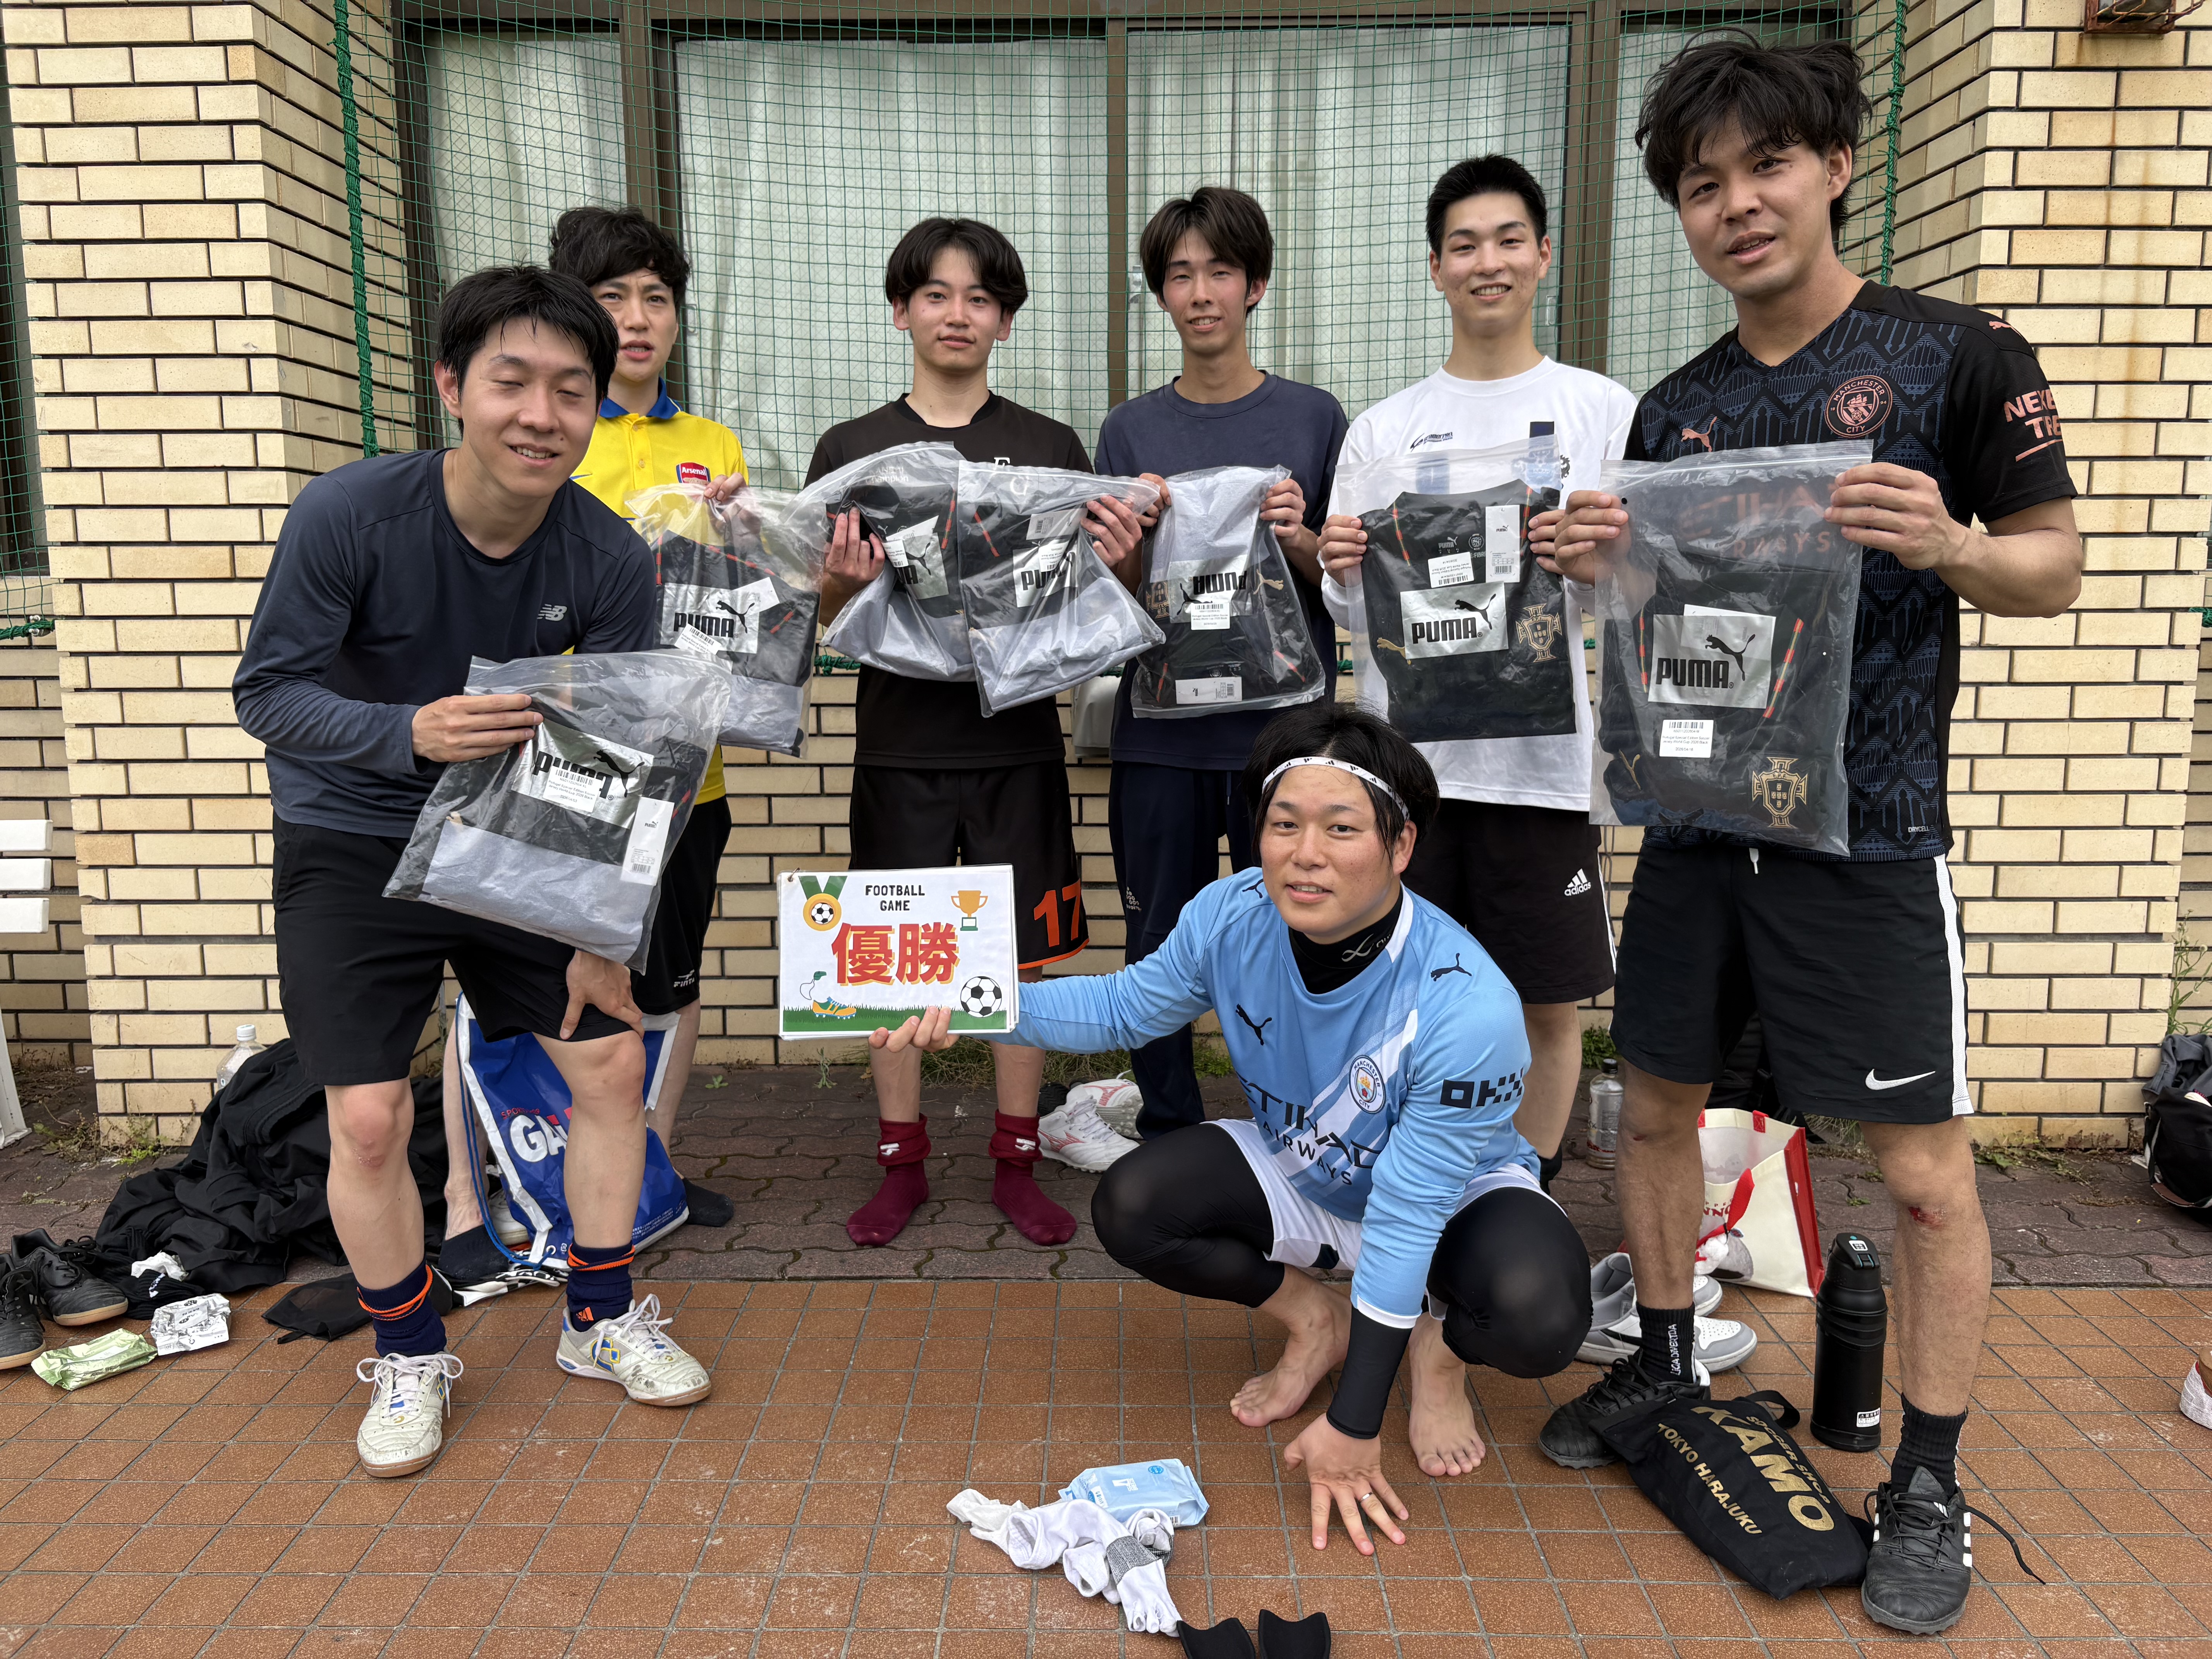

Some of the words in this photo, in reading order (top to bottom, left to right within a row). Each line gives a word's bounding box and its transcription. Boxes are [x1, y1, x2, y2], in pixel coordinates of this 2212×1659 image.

[1833, 380, 1885, 401] MANCHESTER
[1846, 425, 1865, 433] CITY
[681, 465, 706, 477] Arsenal
[1193, 571, 1248, 595] PUMA
[1411, 617, 1480, 644] PUMA
[1655, 658, 1729, 689] PUMA
[865, 885, 925, 896] FOOTBALL
[1565, 882, 1591, 896] adidas
[880, 900, 910, 911] GAME
[1034, 878, 1081, 948] 17
[831, 922, 961, 986] 優勝
[673, 977, 695, 988] FINTA
[1354, 1060, 1381, 1089] MANCHESTER
[1358, 1099, 1370, 1109] CITY
[1263, 1120, 1352, 1185] AIRWAYS
[1690, 1406, 1835, 1531] KAMO
[1746, 1416, 1798, 1462] SOCCER
[1795, 1461, 1831, 1505] SHOP
[1658, 1422, 1698, 1463] TOKYO
[1693, 1462, 1762, 1535] HARAJUKU
